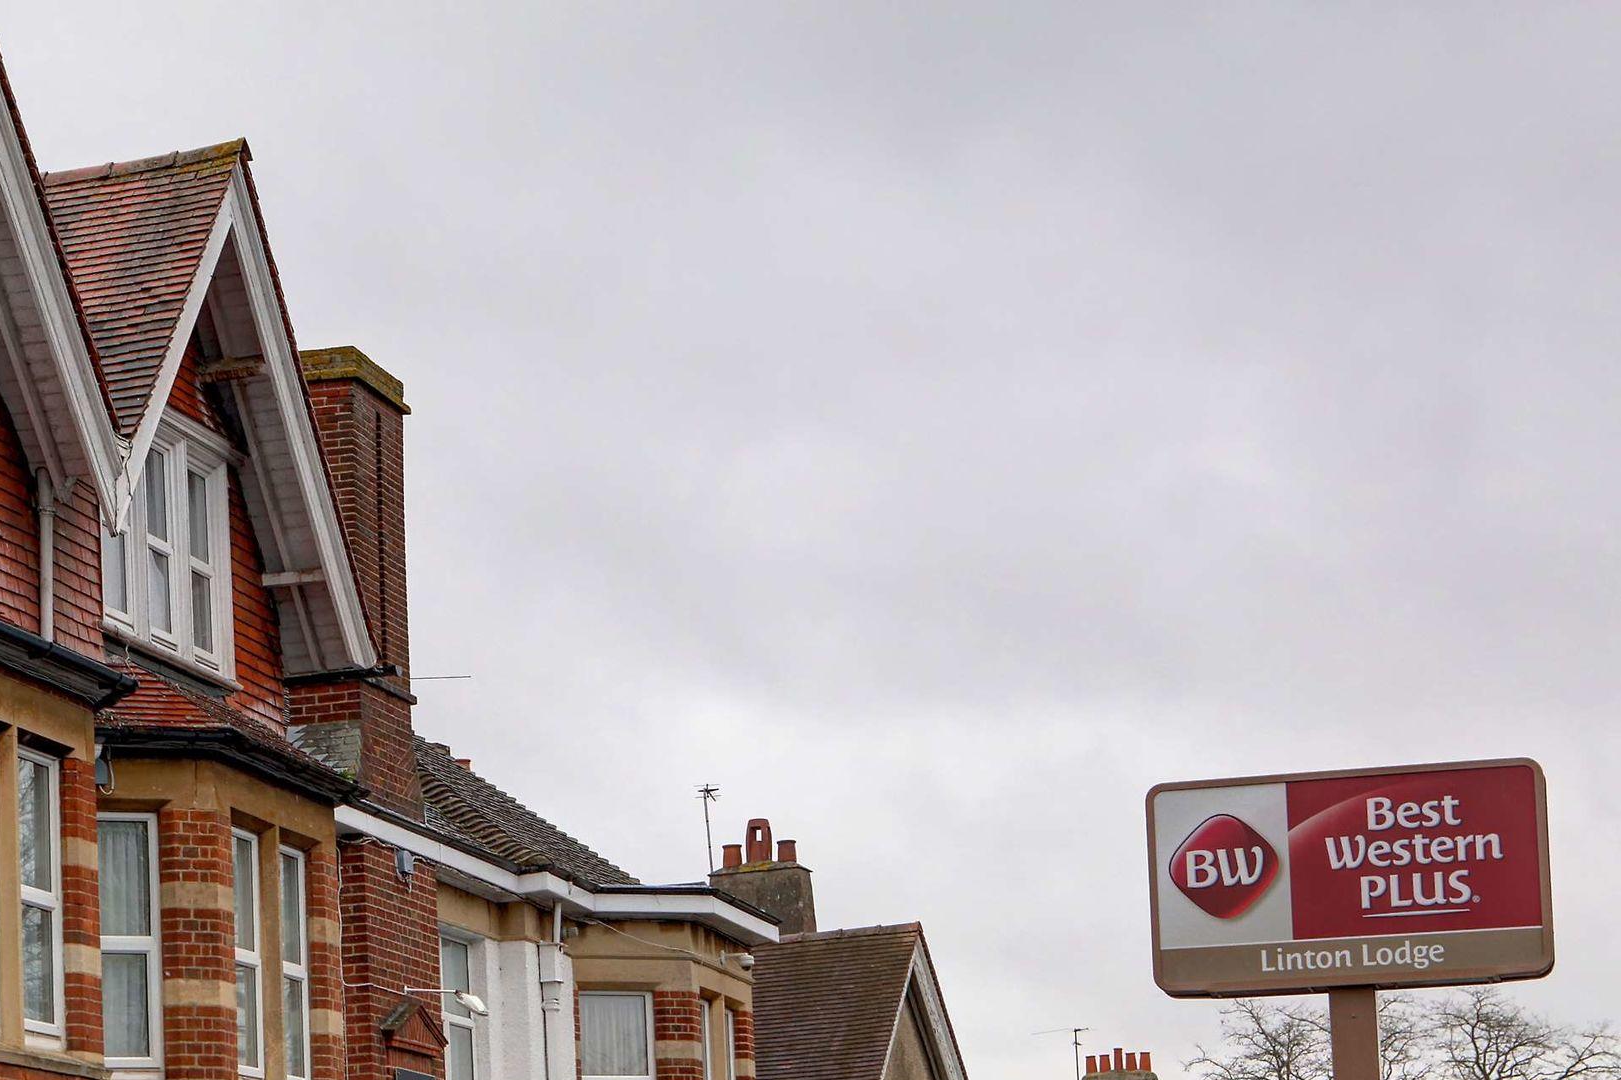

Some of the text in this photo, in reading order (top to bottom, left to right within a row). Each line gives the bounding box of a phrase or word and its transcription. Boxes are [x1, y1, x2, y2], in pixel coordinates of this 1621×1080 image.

[1366, 795, 1462, 831] Best
[1186, 846, 1264, 889] BW
[1325, 833, 1504, 870] Western
[1360, 869, 1472, 909] PLUS
[1260, 940, 1445, 972] Linton Lodge
